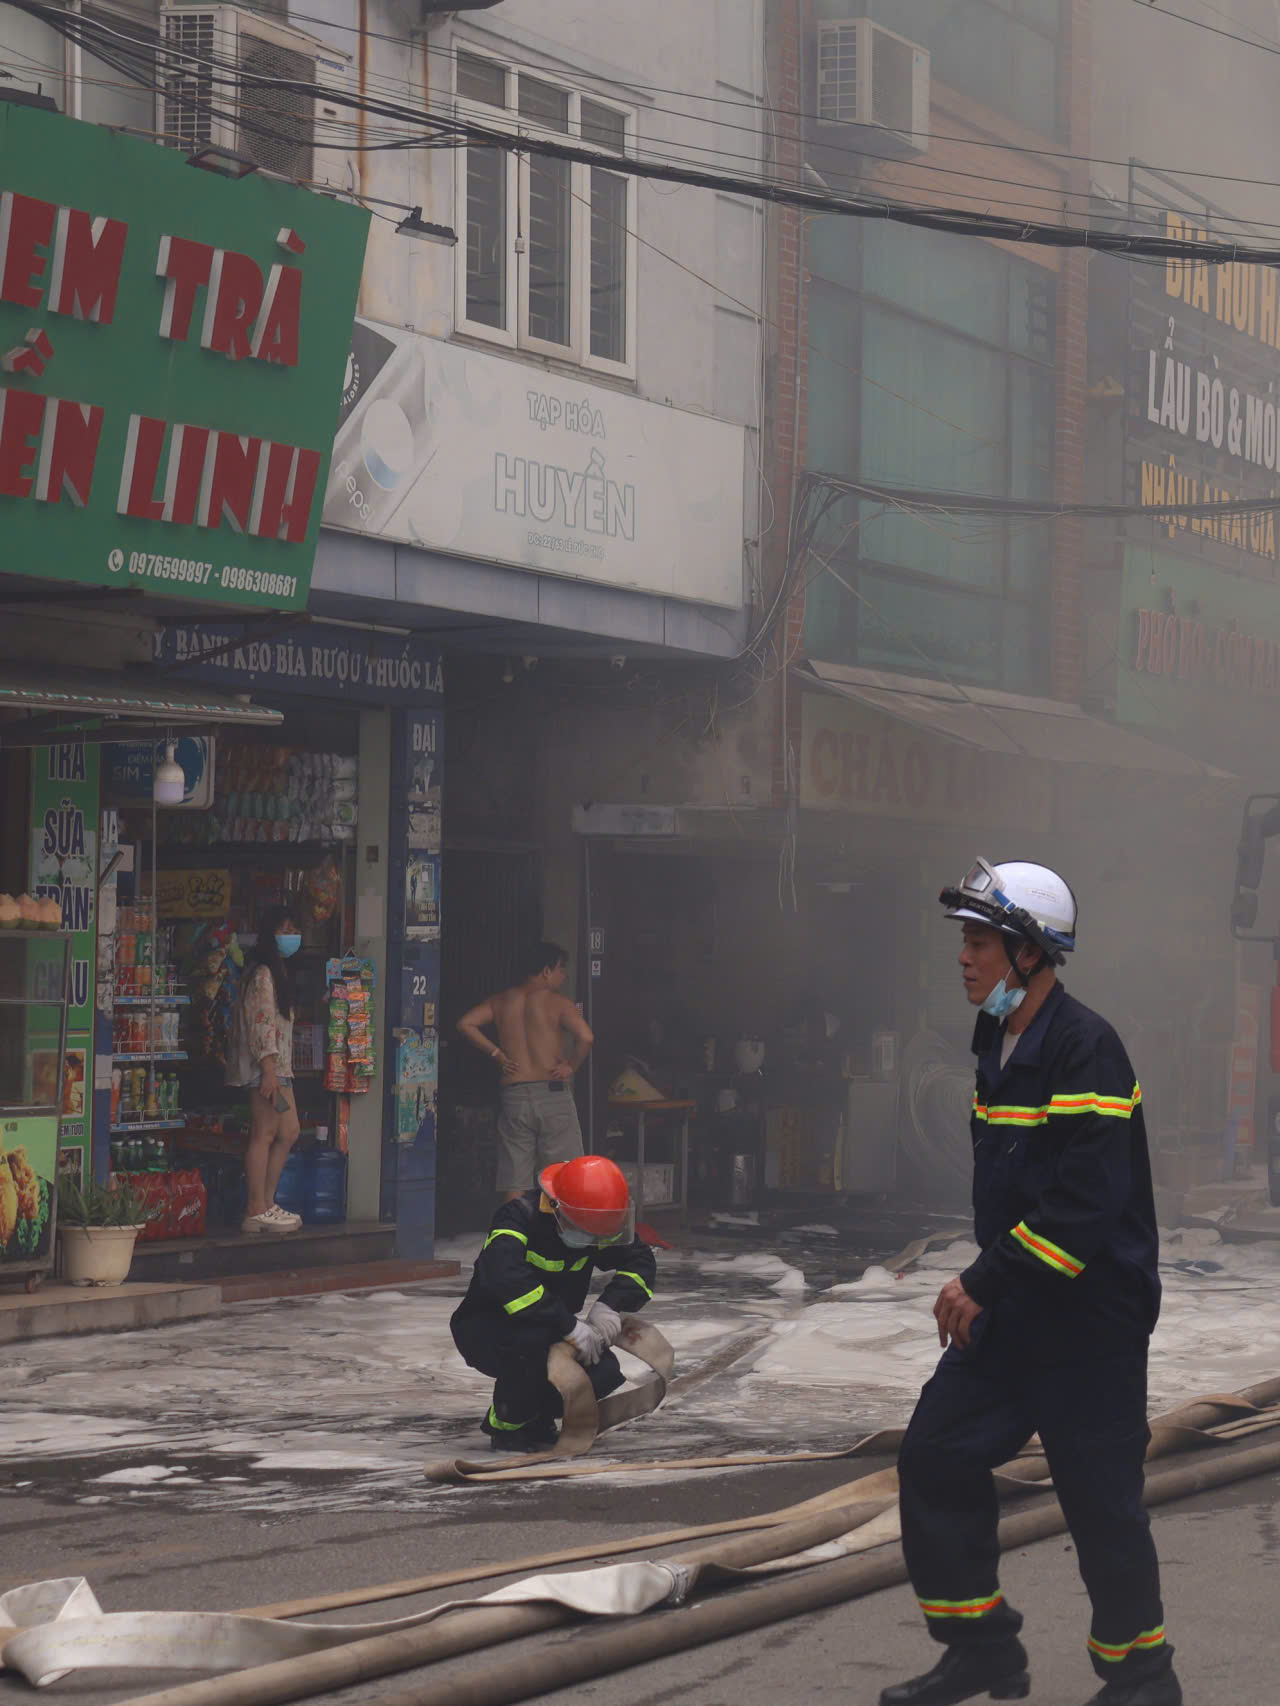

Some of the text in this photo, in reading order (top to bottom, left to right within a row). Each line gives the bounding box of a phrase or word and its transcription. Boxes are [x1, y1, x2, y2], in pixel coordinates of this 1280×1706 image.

[1164, 211, 1209, 314] BIA
[156, 228, 306, 367] TRÀ
[1147, 315, 1191, 436] LẨU
[1195, 354, 1224, 449] BÒ
[1227, 387, 1243, 457] &
[527, 390, 606, 440] TẠP HÓA
[116, 413, 322, 544] LINH
[494, 446, 636, 542] HUYỀN
[128, 551, 212, 585] 0976599897
[221, 566, 297, 598] 0986308681
[233, 642, 272, 680] KẸO
[311, 648, 361, 688] RƯỢU
[365, 640, 421, 689] THUỐC
[425, 655, 444, 693] LÁ
[412, 718, 436, 758] ĐẠI
[45, 798, 85, 856] SỮA
[36, 877, 90, 931] ÂN
[33, 960, 89, 1006] CHU
[412, 975, 427, 995] 22
